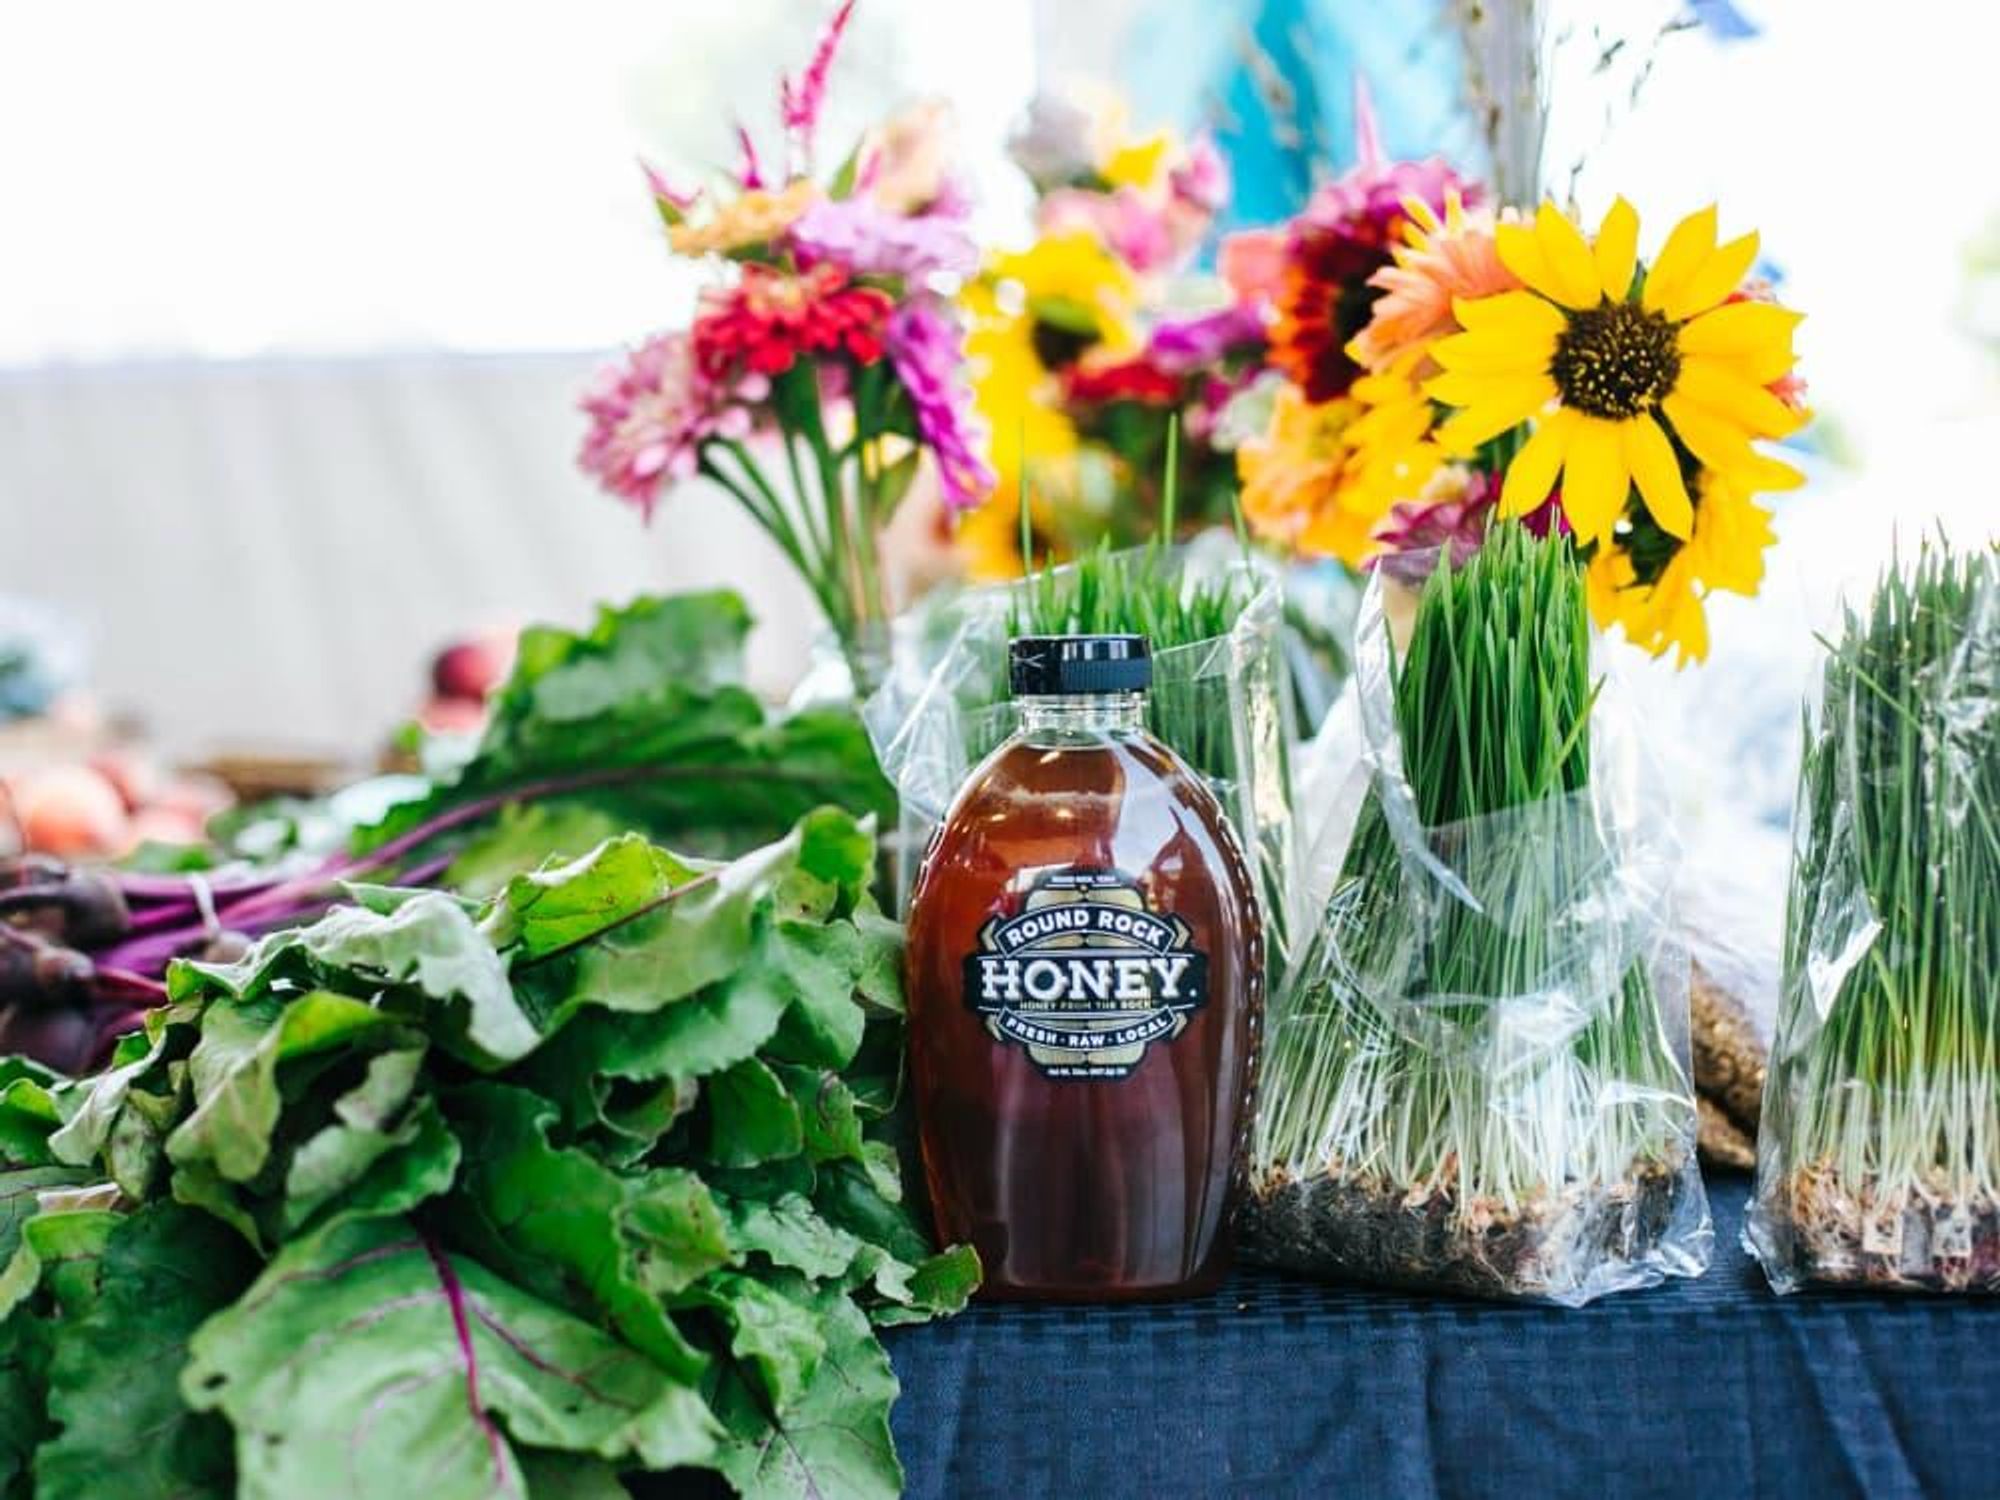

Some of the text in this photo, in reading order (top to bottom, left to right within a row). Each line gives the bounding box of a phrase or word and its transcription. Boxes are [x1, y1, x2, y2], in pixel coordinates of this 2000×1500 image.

[1006, 910, 1166, 947] ROUND ROCK
[1020, 1000, 1056, 1010] HONEY
[1006, 1017, 1168, 1047] FRESH RAW LOCAL
